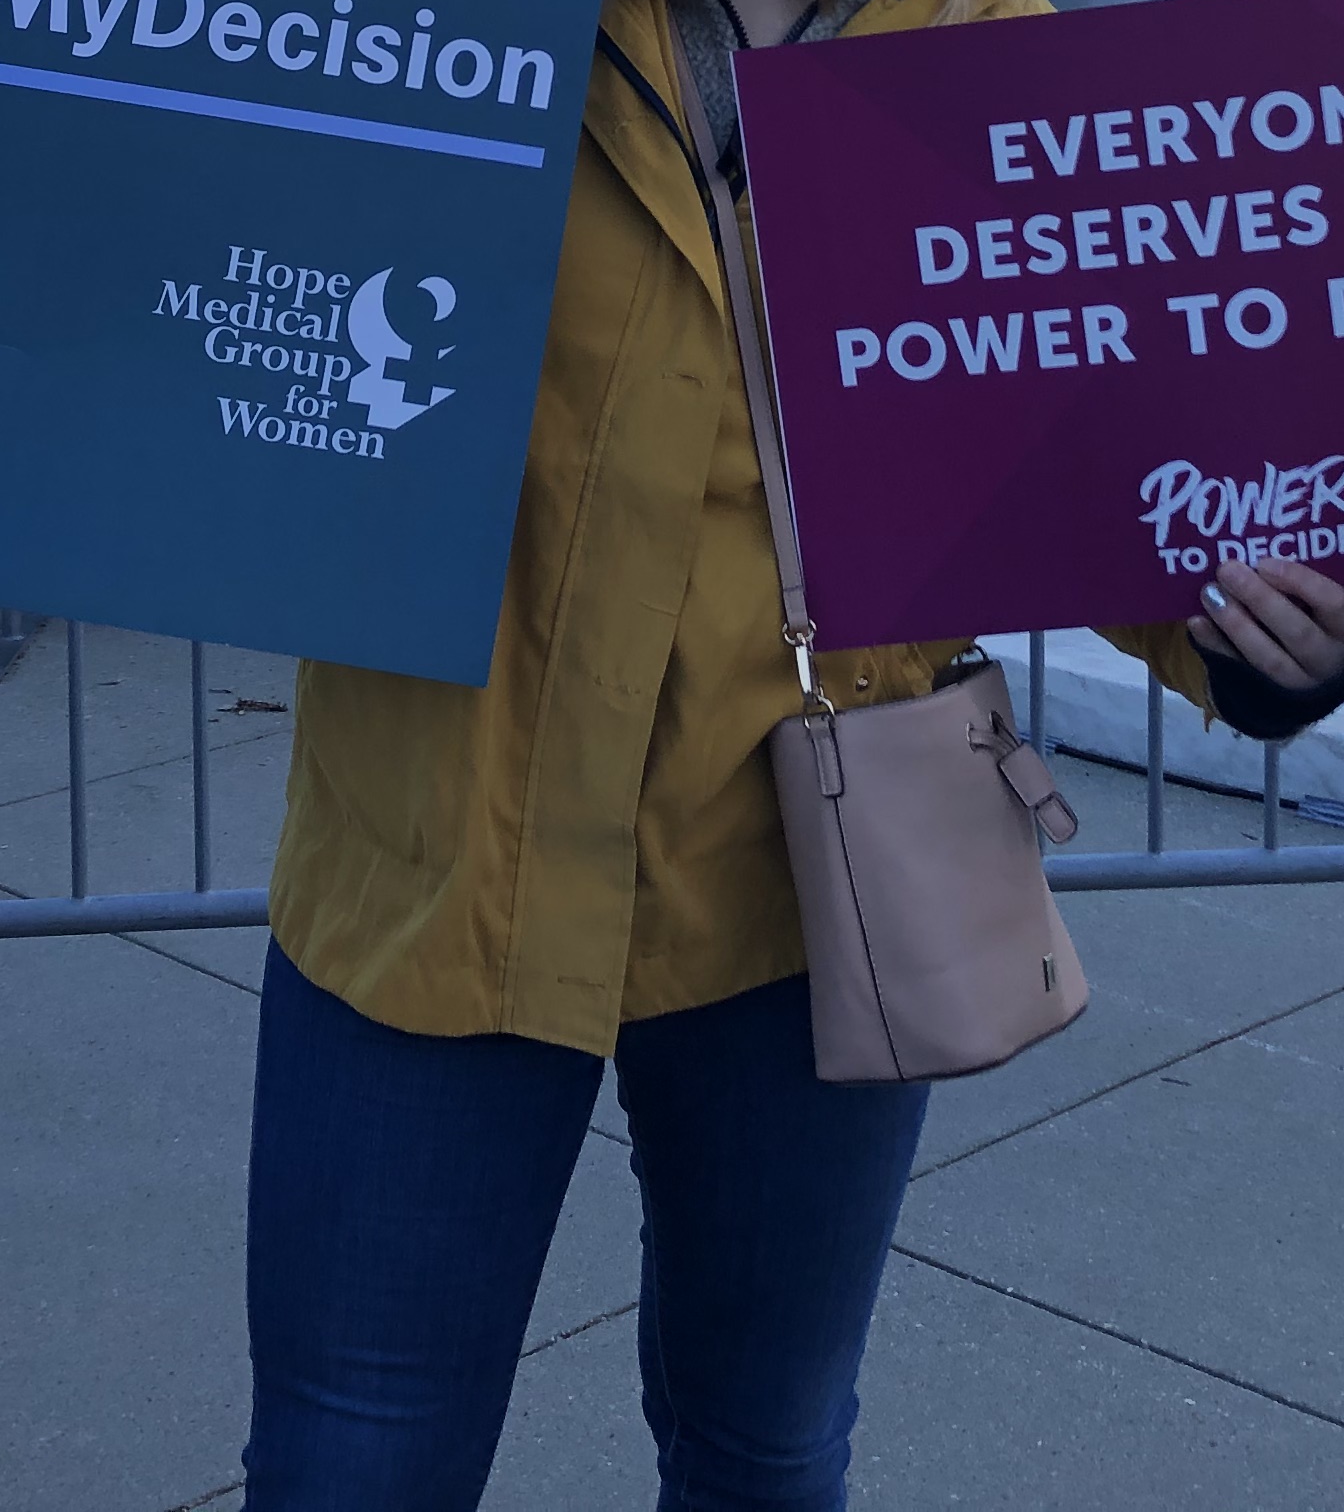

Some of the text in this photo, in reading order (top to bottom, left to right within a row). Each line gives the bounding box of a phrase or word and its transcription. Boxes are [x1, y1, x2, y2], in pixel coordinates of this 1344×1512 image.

[914, 184, 1331, 286] DESERVES
[222, 245, 351, 309] Hope
[151, 279, 342, 343] Medical
[835, 303, 1136, 388] POWER
[1166, 286, 1289, 356] TO
[204, 325, 352, 396] Group
[216, 396, 385, 460] Women
[283, 384, 338, 419] for
[1158, 546, 1208, 574] TO
